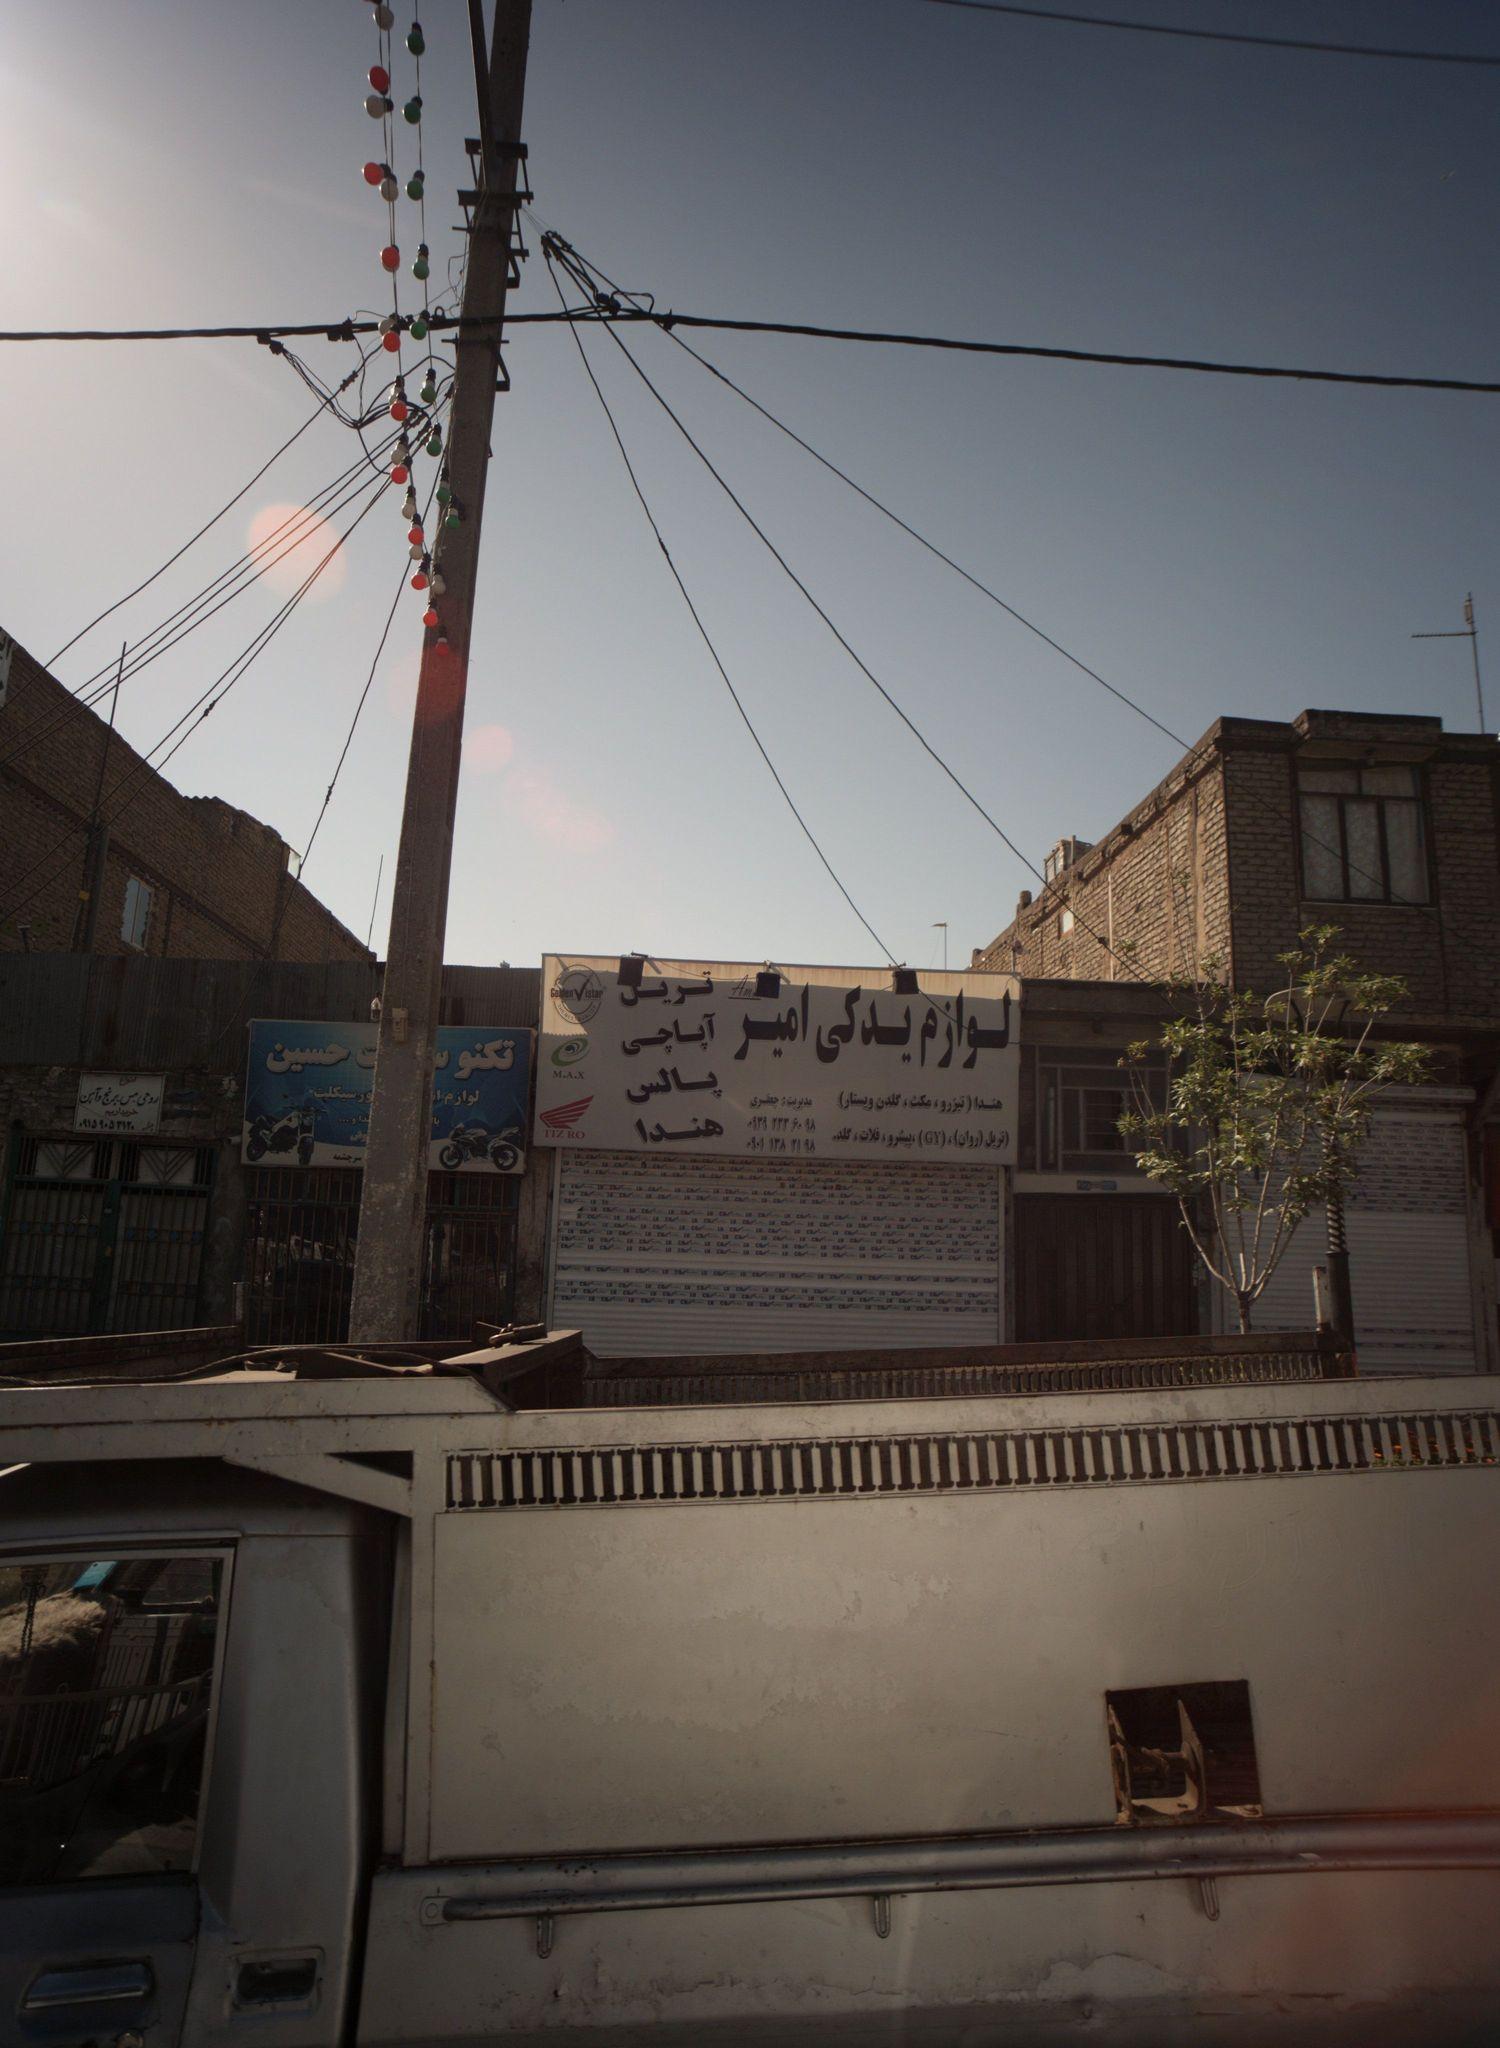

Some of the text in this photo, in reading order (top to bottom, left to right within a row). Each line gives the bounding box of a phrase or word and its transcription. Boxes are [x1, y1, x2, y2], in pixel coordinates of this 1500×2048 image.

[620, 970, 714, 1006] تریل
[622, 1012, 716, 1055] آپاچی
[734, 982, 1012, 1068] لوازم یدکی امیر
[266, 1042, 352, 1073] حسین
[454, 1040, 516, 1079] تکنو
[552, 1070, 585, 1080] M.A.X
[627, 1066, 723, 1103] پالس
[444, 1089, 480, 1106] لوازم
[877, 1093, 901, 1109] گلدن
[974, 1096, 1003, 1110] هندا
[636, 1117, 724, 1144] هندا
